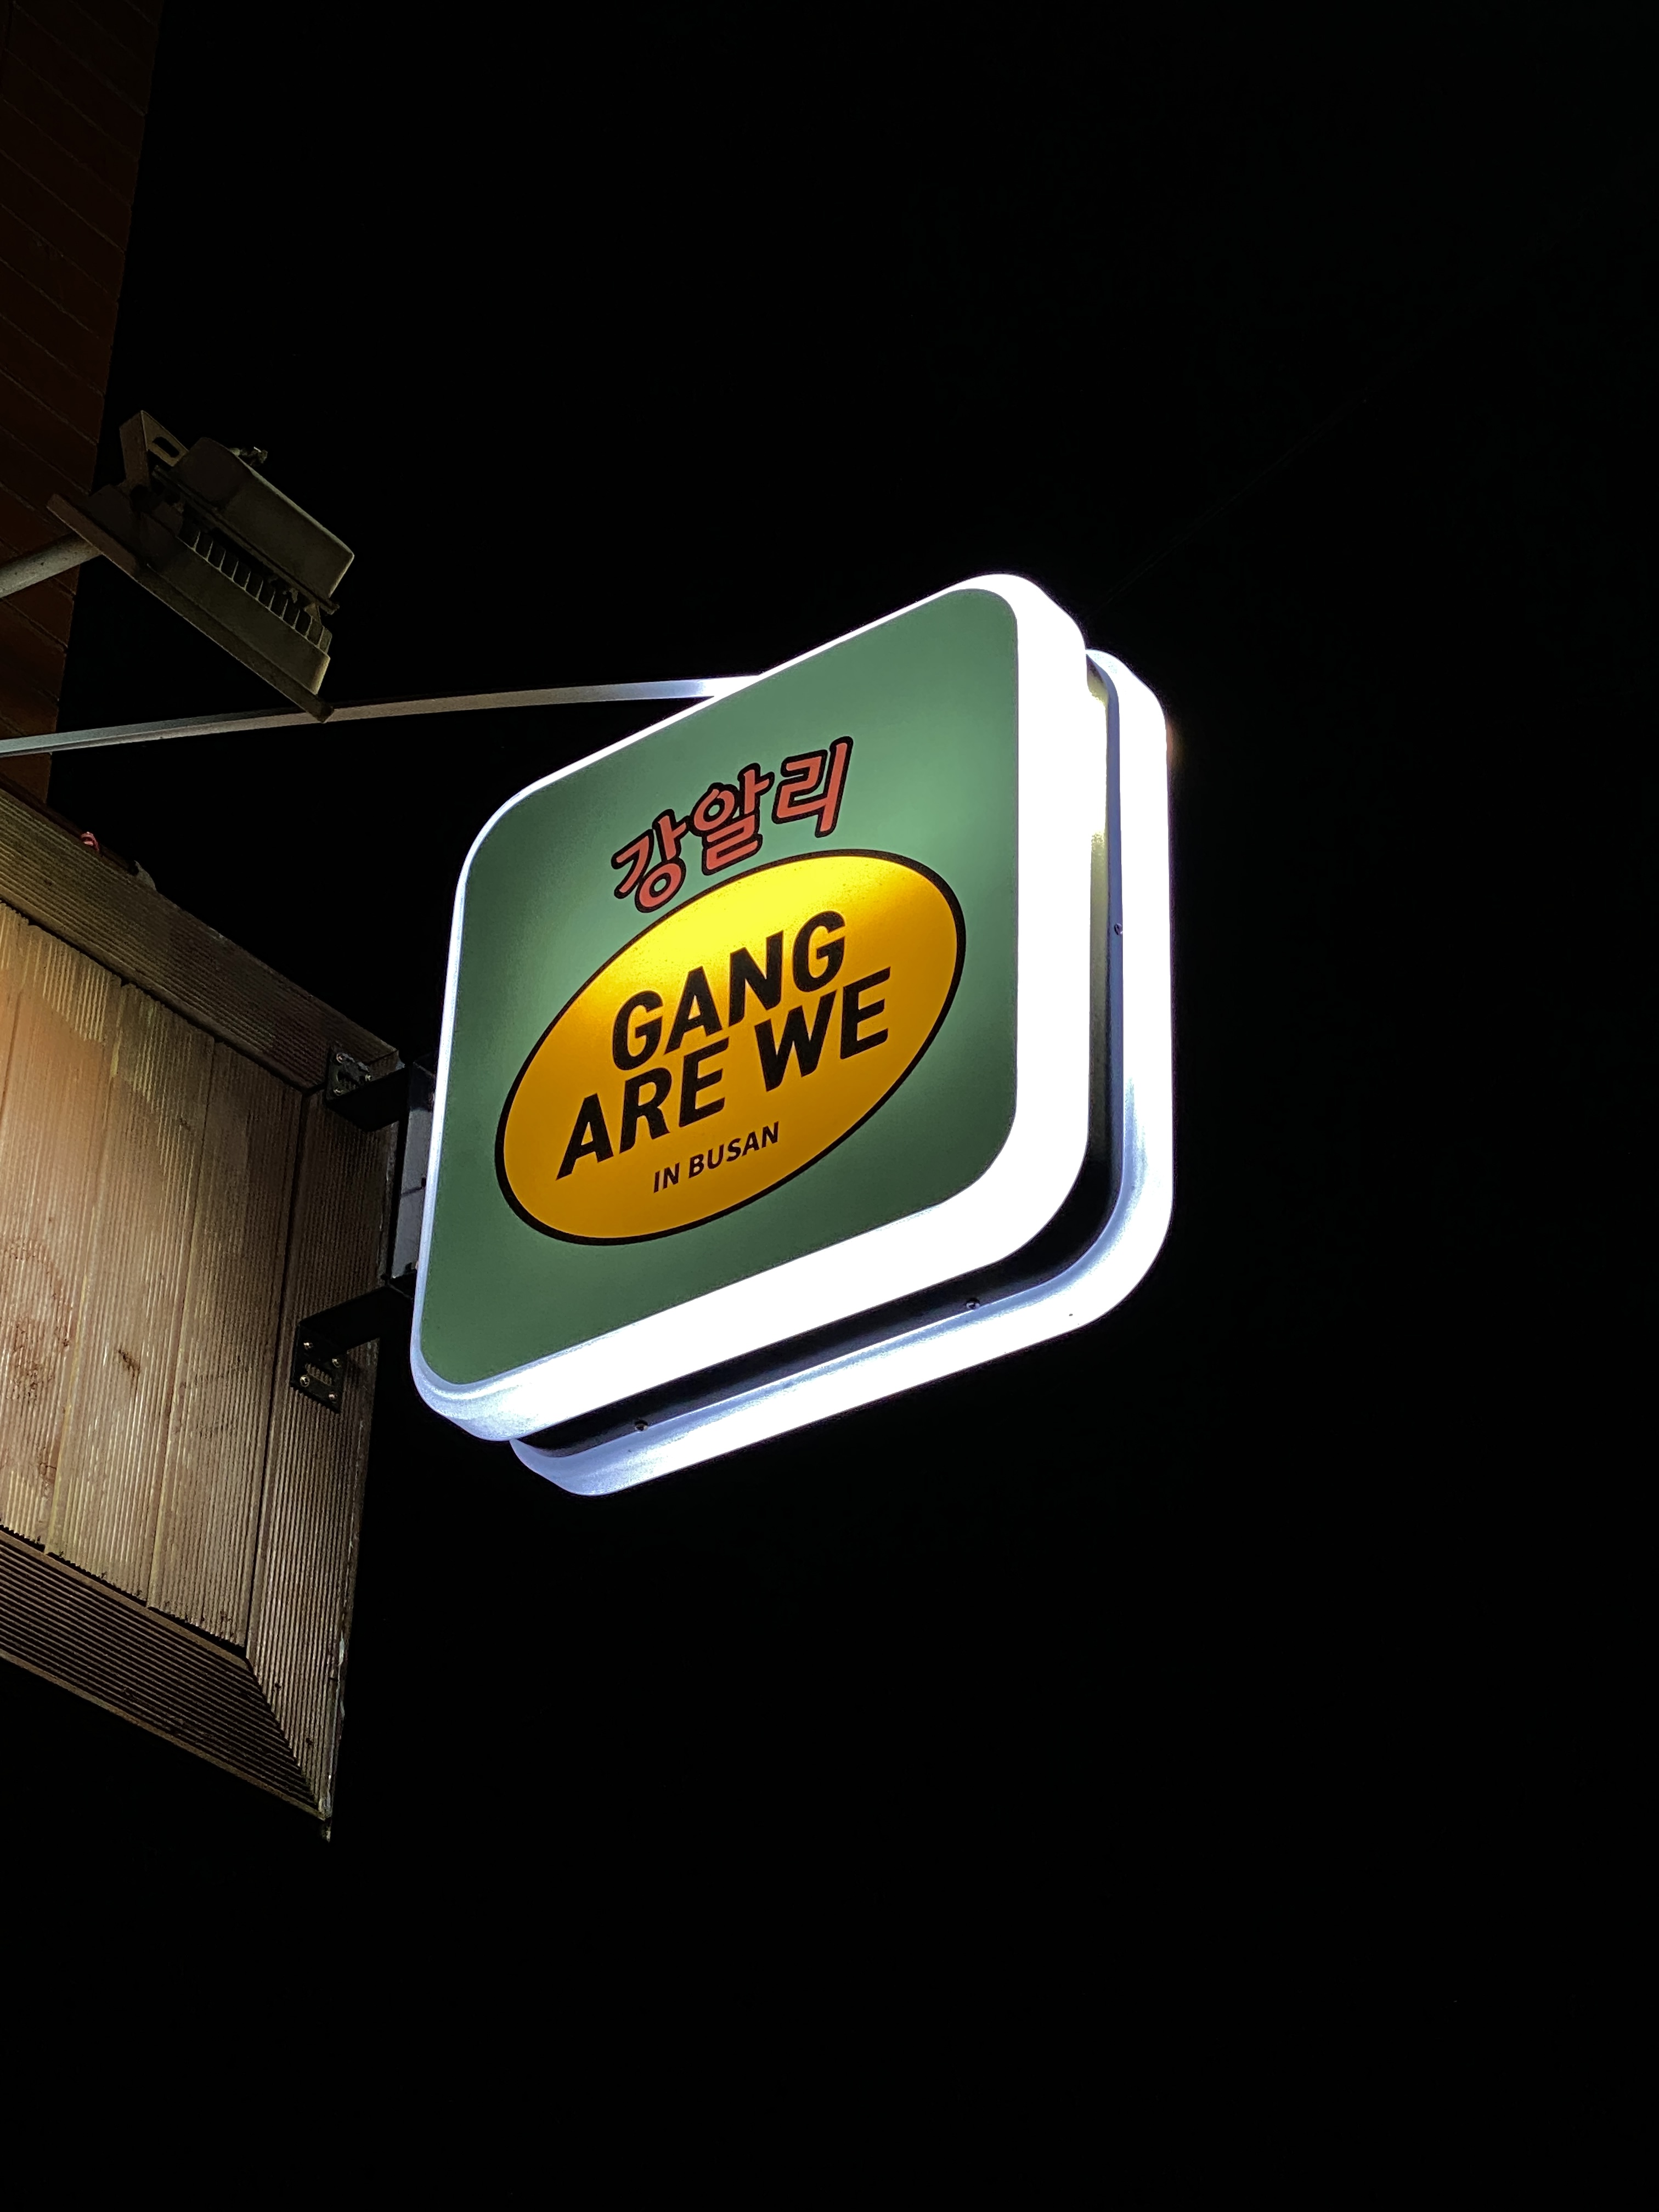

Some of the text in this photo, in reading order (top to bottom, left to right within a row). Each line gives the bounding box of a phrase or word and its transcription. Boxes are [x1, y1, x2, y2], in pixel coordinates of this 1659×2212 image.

[611, 736, 853, 912] 강알리
[556, 967, 891, 1181] ARE WE
[612, 911, 846, 1070] GANG
[653, 1121, 780, 1193] IN BUSAN
